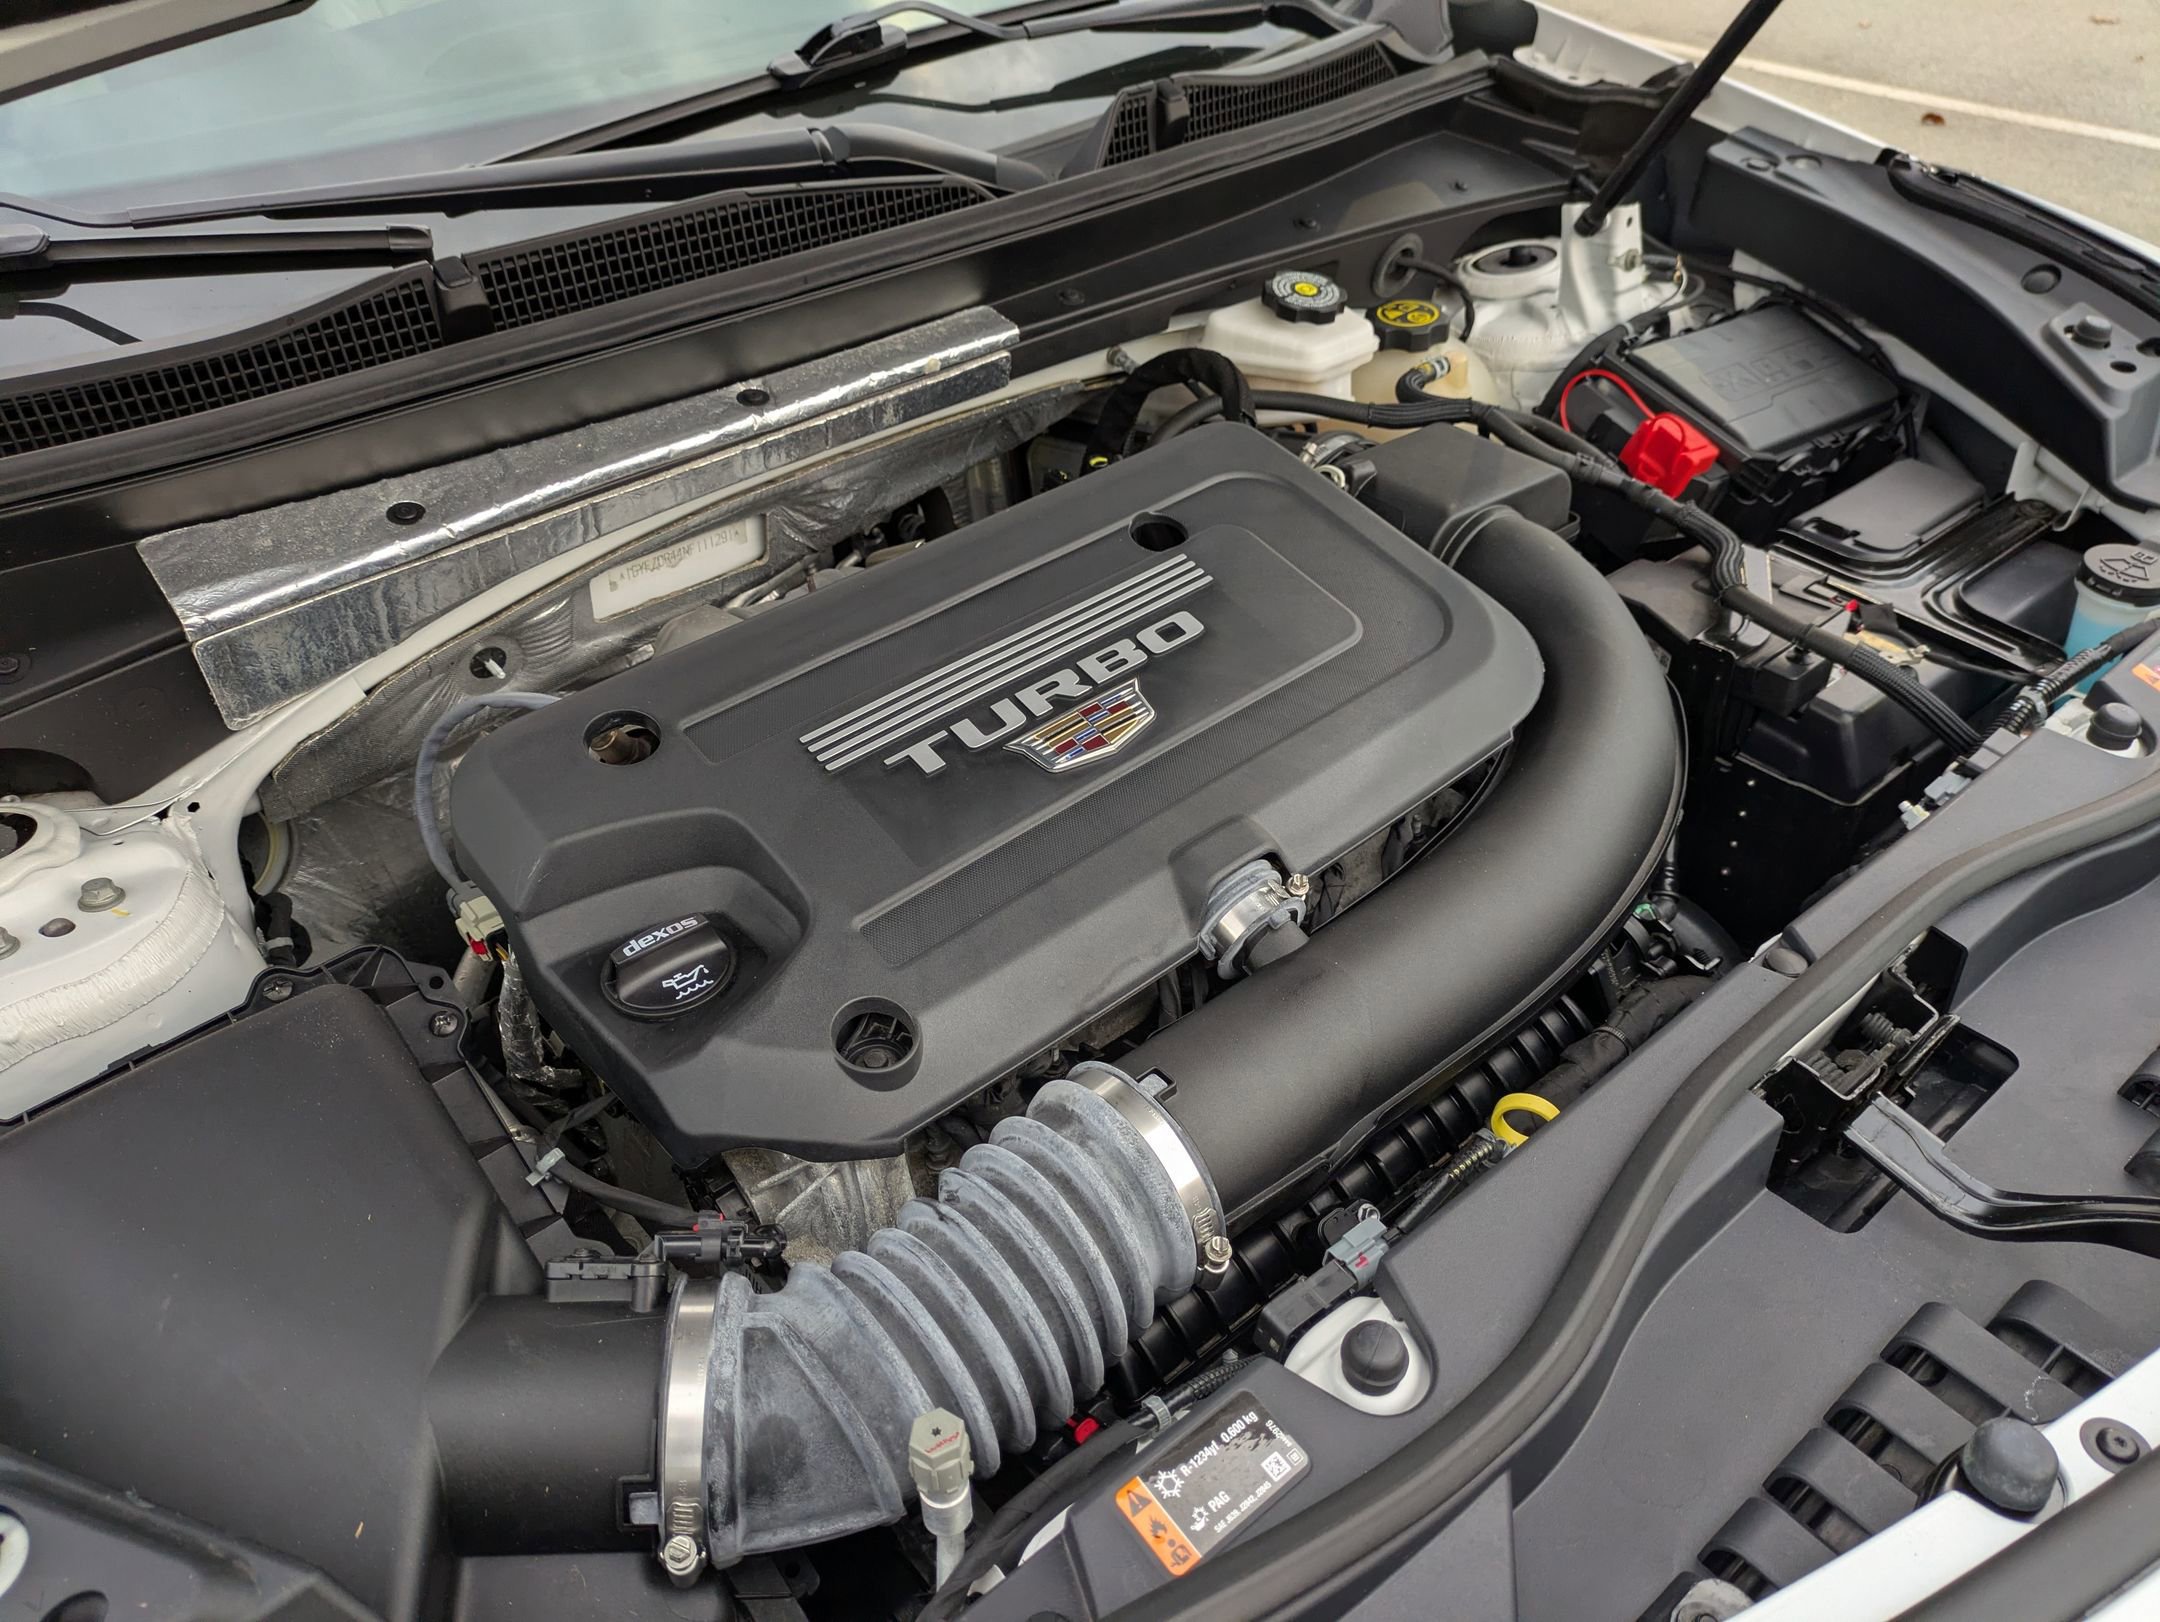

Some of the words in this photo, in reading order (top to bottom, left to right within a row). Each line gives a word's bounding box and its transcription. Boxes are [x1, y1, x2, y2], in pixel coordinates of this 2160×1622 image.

[883, 610, 1205, 777] TURBO
[622, 916, 698, 957] dexos
[1180, 1440, 1220, 1478] R-1234yf
[1220, 1419, 1246, 1444] 0.600
[1243, 1410, 1259, 1426] kg
[1208, 1491, 1230, 1512] PAG
